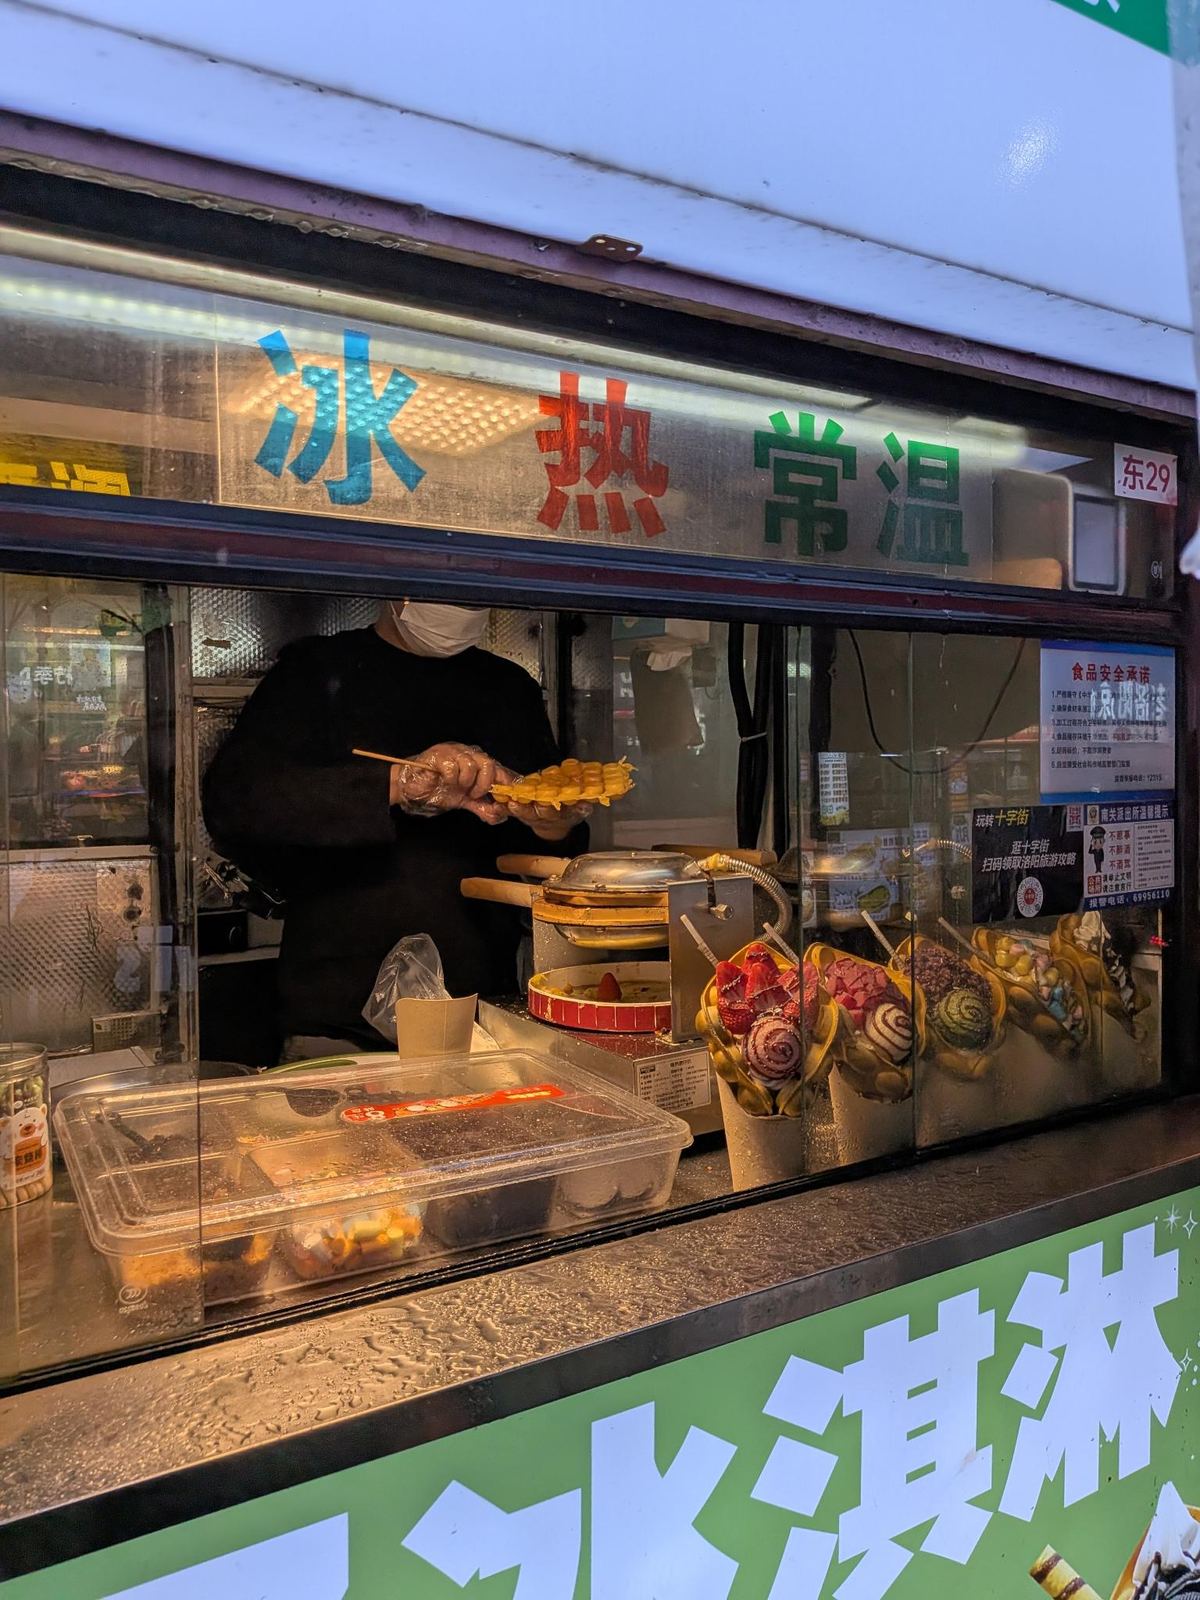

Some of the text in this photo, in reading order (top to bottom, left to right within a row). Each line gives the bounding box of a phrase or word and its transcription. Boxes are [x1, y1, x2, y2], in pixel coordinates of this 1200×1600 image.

[255, 328, 970, 567] 冰 热 常温
[1121, 455, 1171, 494] 东29
[1072, 662, 1151, 684] 食品安全承诺
[975, 808, 1029, 827] 玩转十字街
[1011, 839, 1050, 855] 逛十字街
[981, 852, 1077, 872] 扫码领取洛阳旅游攻略
[92, 1222, 1183, 1600] 冰淇淋
